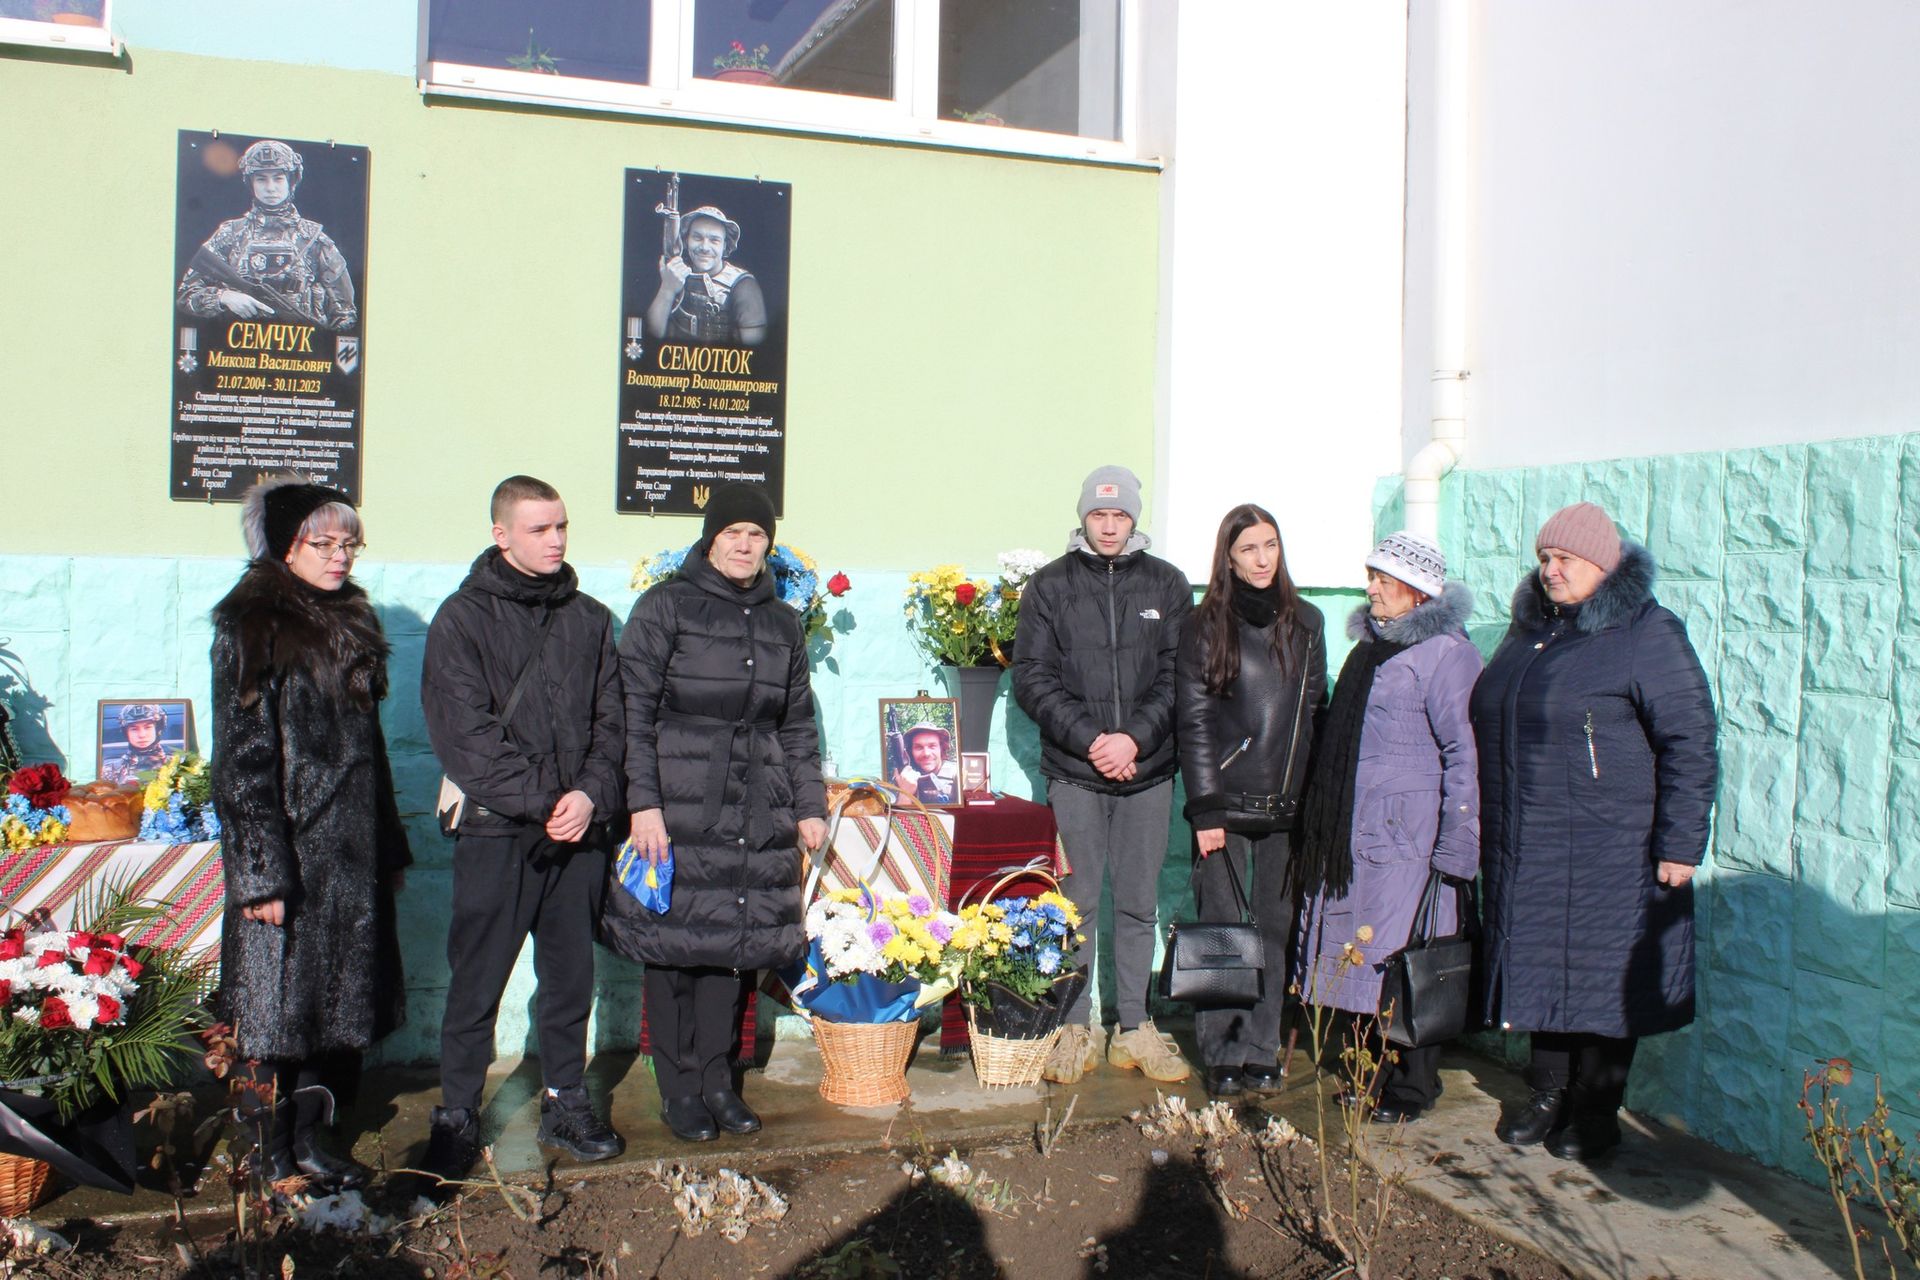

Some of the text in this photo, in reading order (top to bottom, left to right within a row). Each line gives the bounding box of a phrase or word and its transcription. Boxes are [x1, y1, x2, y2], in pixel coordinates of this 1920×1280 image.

[227, 322, 316, 352] СЕМЧУК
[208, 351, 332, 373] Микола Васильович
[658, 344, 753, 375] СЕМОТЮК
[217, 375, 266, 390] 21.07.2004
[273, 379, 321, 393] 30.11.2023
[626, 369, 779, 396] Володимир Володимирович
[659, 394, 701, 409] 18.12.1985
[708, 397, 750, 411] 14.01.2024
